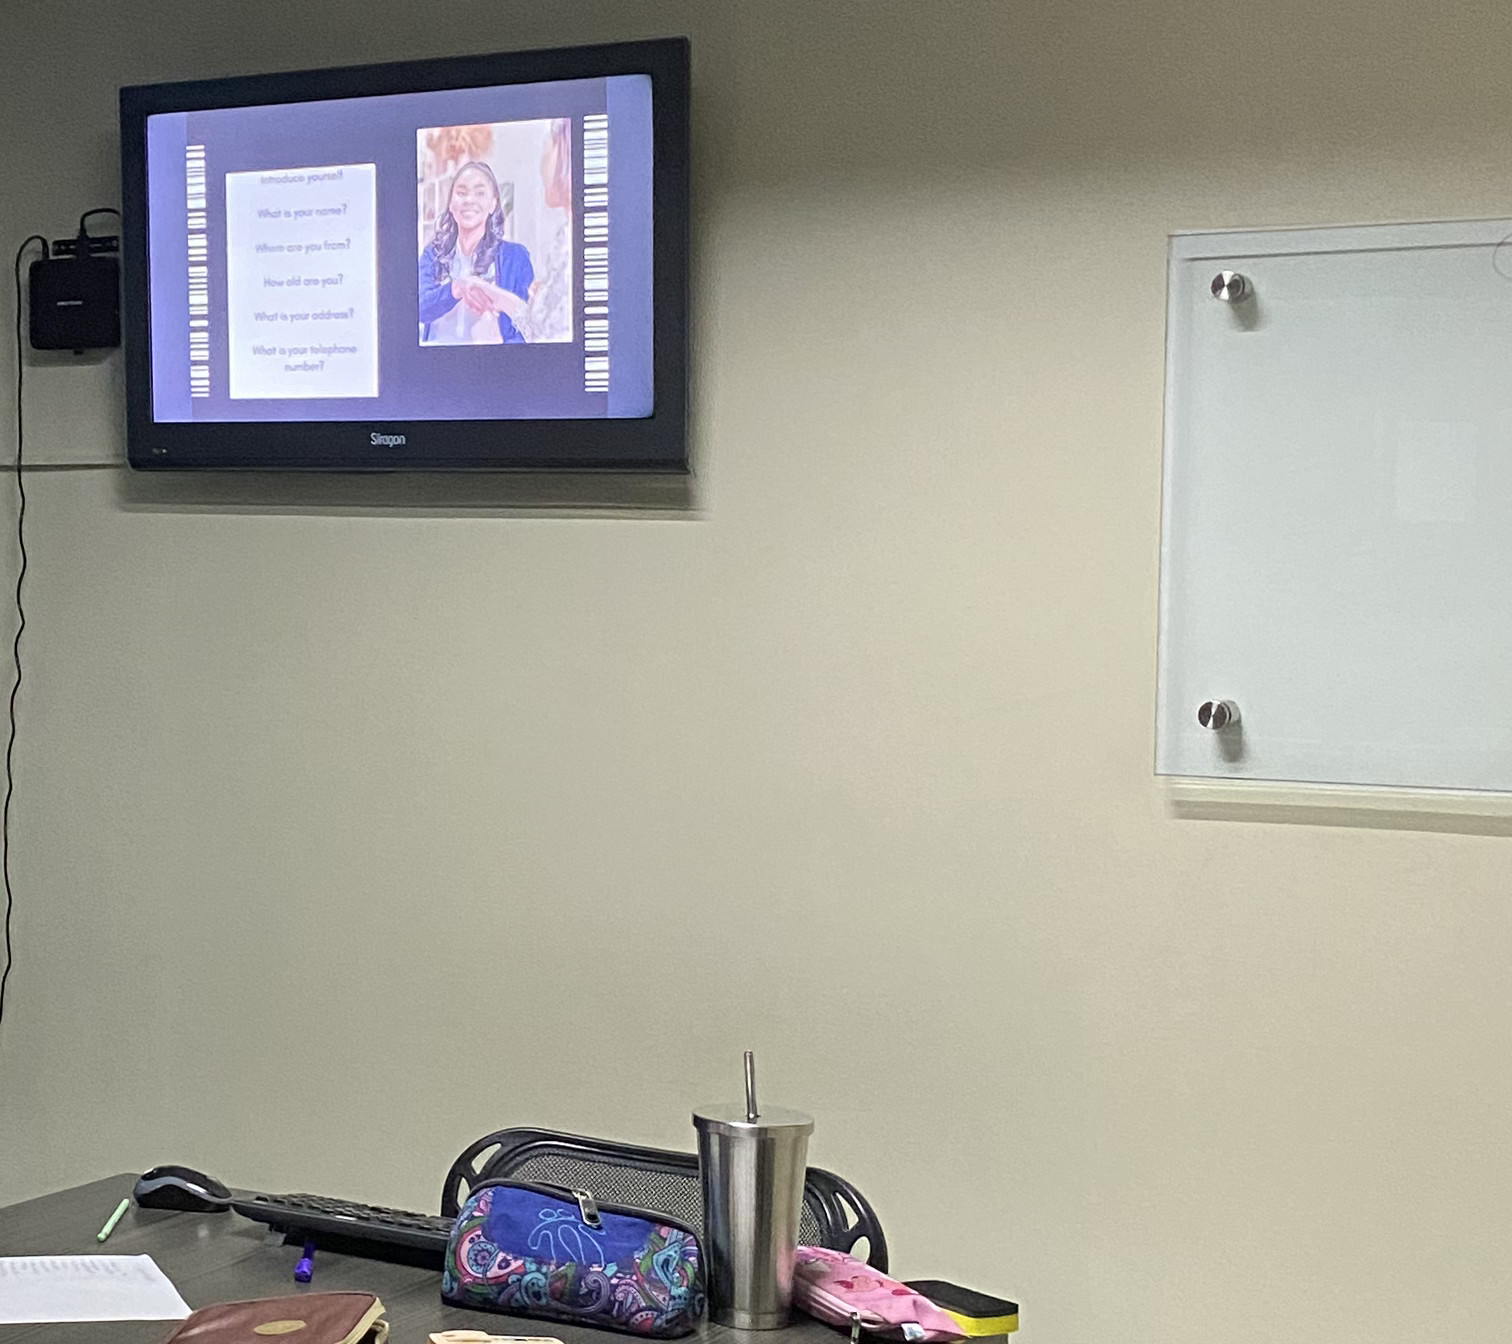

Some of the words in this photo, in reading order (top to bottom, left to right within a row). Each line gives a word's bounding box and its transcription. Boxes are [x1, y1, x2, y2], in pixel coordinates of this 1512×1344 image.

[257, 209, 281, 219] What
[283, 209, 292, 218] is
[293, 208, 313, 221] your
[315, 203, 347, 215] name?
[286, 244, 303, 252] are
[305, 244, 322, 255] you
[323, 238, 351, 250] from?
[263, 278, 284, 288] How
[286, 276, 301, 287] old
[303, 278, 319, 286] are
[321, 273, 344, 288] you?
[254, 311, 278, 322] What
[279, 313, 288, 321] is
[290, 312, 310, 323] your
[311, 308, 354, 320] address?
[252, 345, 277, 356] What
[278, 346, 286, 355] is
[288, 346, 308, 357] your
[309, 344, 358, 357] telephone
[284, 360, 325, 372] number?
